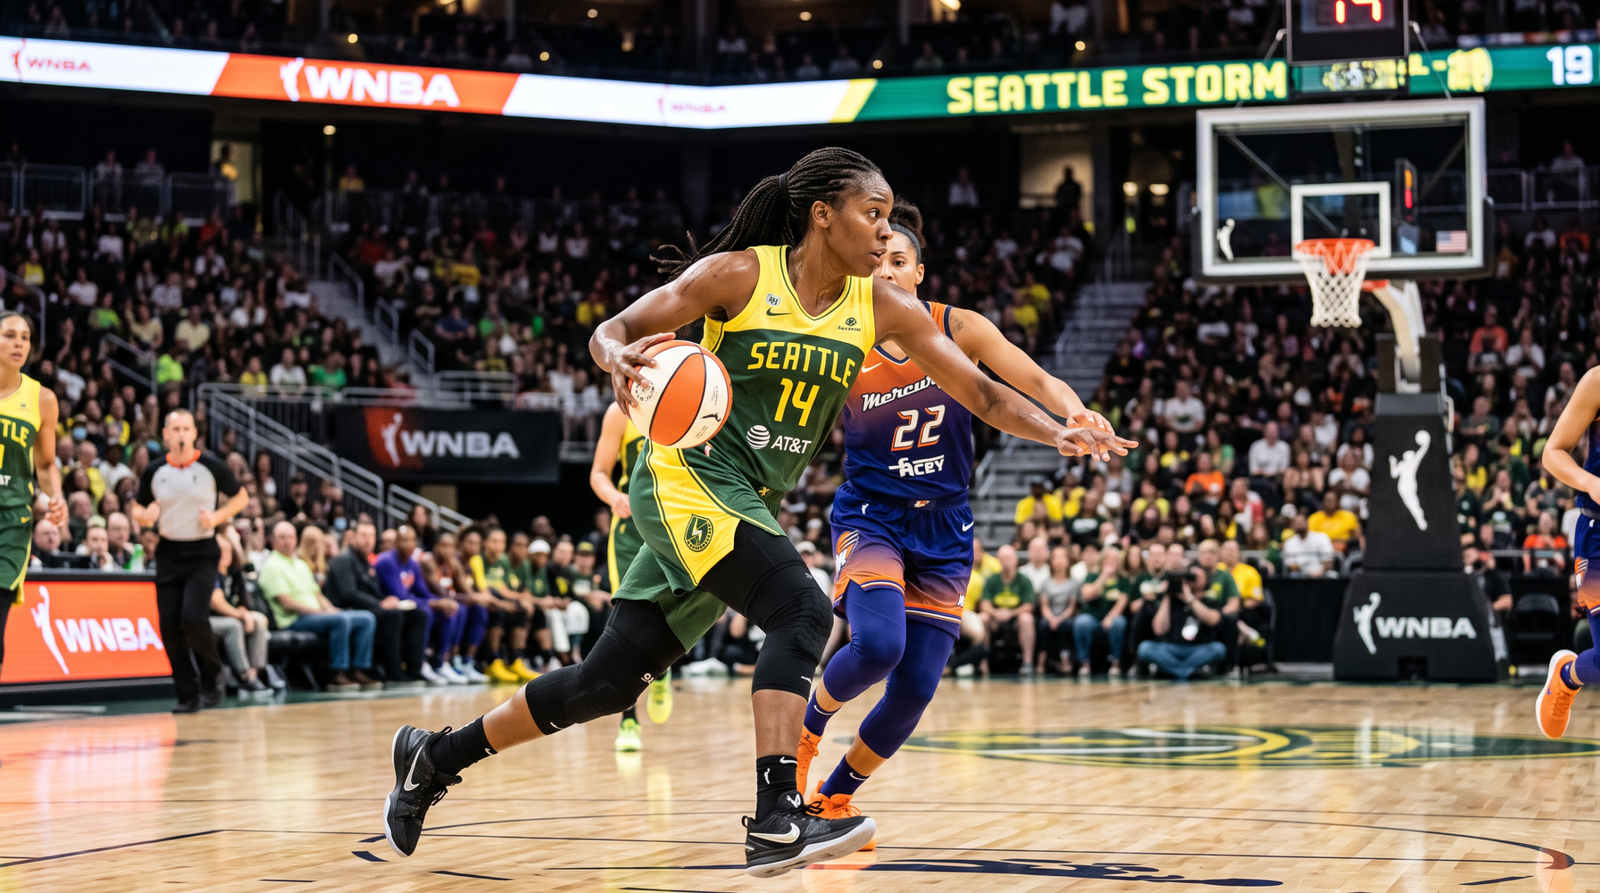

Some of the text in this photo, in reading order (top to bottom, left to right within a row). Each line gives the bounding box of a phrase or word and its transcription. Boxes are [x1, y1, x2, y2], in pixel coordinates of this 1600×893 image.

[26, 57, 92, 71] WNBA
[1546, 45, 1593, 86] 19
[305, 66, 460, 107] WNBA
[947, 69, 1128, 114] SEATTLE
[1142, 61, 1287, 105] STORM
[747, 341, 856, 389] SEATTLE
[774, 377, 820, 427] 14
[862, 376, 942, 412] Mercur
[400, 430, 521, 459] WNBA
[770, 435, 813, 454] AT&T
[890, 404, 946, 452] 22
[55, 617, 165, 653] WNBA
[1375, 616, 1478, 640] WNBA
